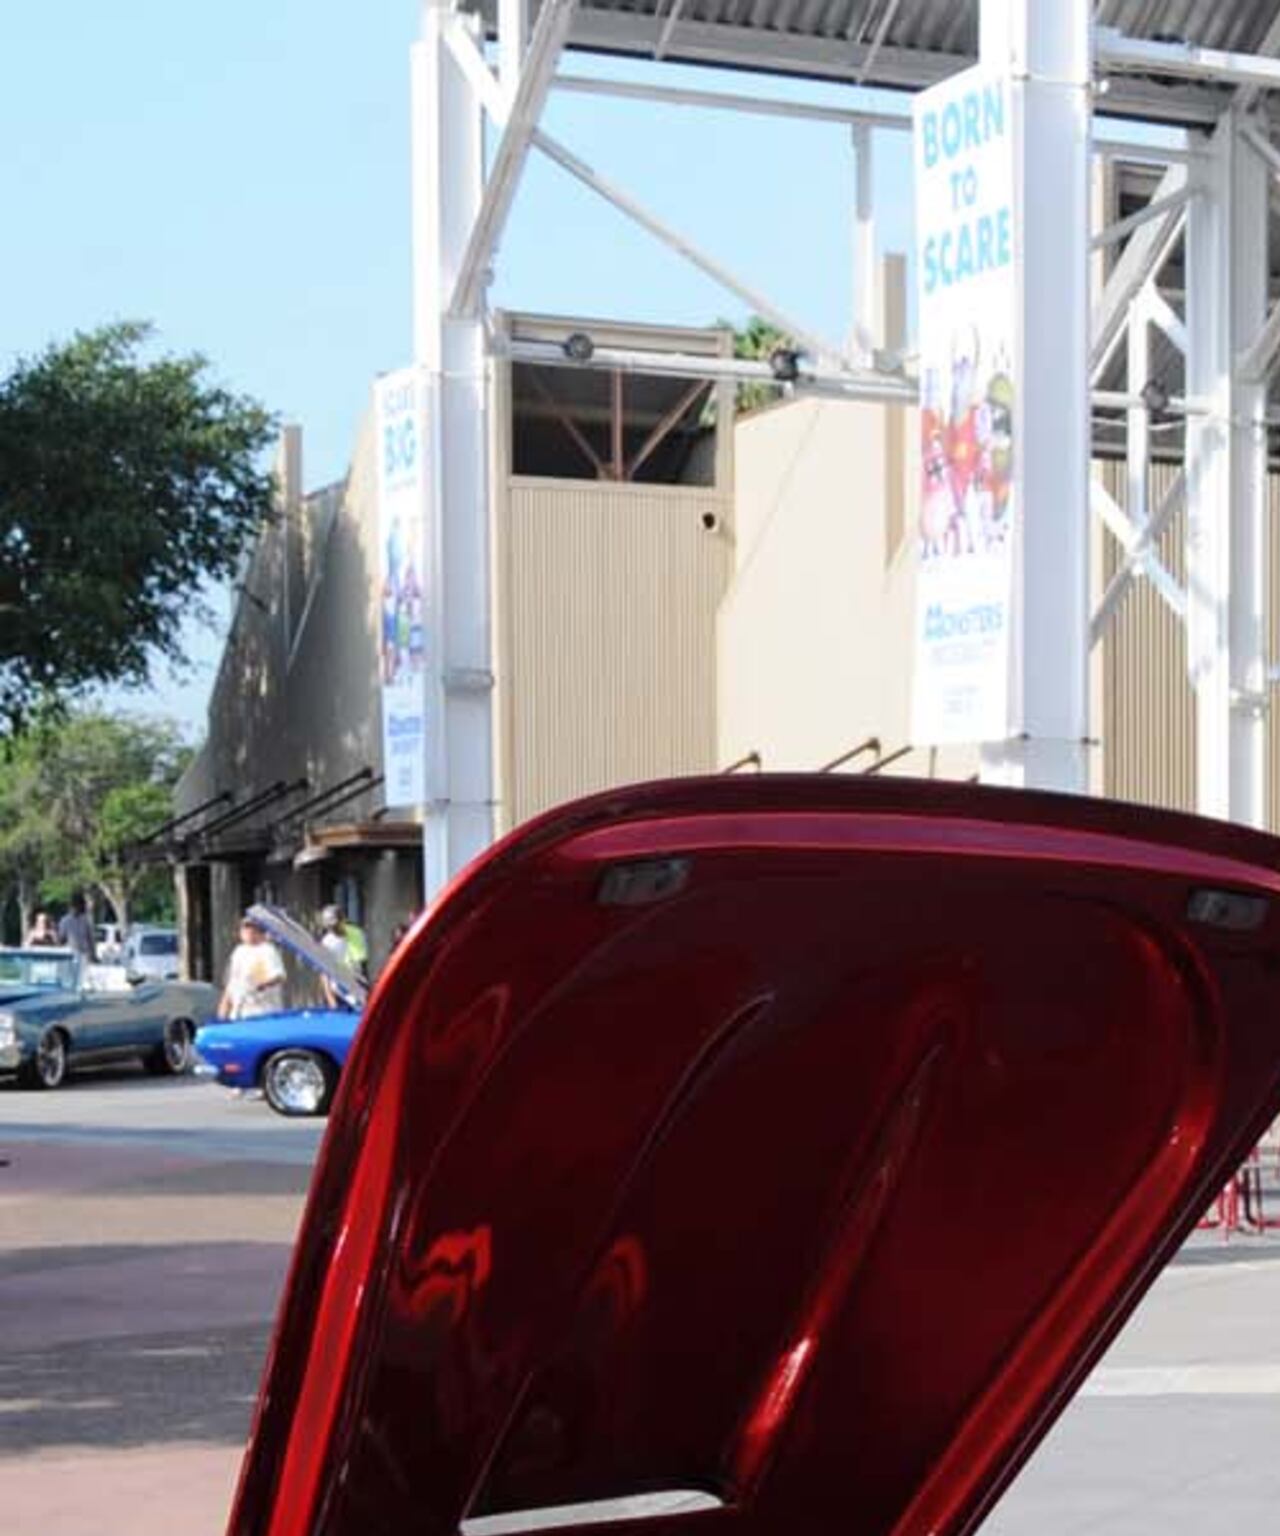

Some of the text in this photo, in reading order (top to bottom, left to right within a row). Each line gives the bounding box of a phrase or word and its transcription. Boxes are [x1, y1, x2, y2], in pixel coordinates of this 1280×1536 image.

[922, 76, 1004, 168] BORN
[950, 165, 978, 210] TO
[922, 206, 1011, 294] SCARE
